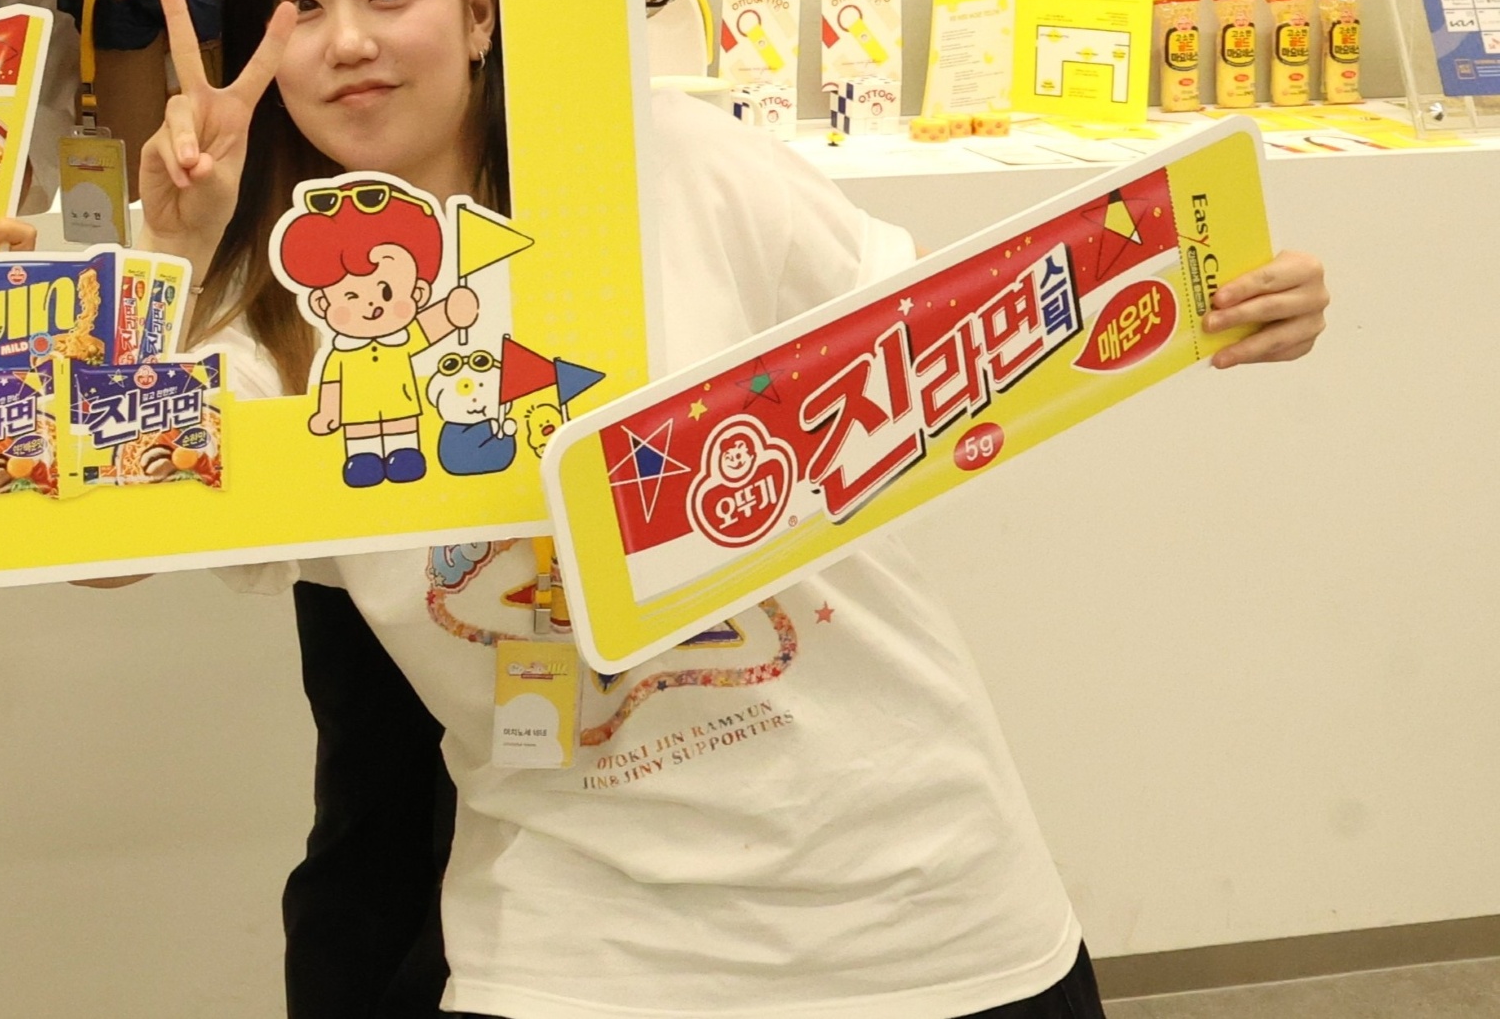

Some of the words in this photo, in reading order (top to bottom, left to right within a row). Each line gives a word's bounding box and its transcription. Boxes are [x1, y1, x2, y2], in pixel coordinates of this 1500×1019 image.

[858, 89, 896, 104] OTTOGI
[1179, 193, 1210, 248] Easy
[1203, 253, 1219, 298] Cu
[0, 341, 29, 356] MILD
[1098, 285, 1161, 364] 매운맛
[800, 269, 1046, 518] 진라면
[1040, 255, 1075, 337] 스틱
[89, 389, 202, 450] 진라면
[964, 436, 995, 462] 5g
[715, 474, 778, 530] 오뚜기
[655, 731, 685, 753] JIN
[691, 699, 774, 737] RAMYUN
